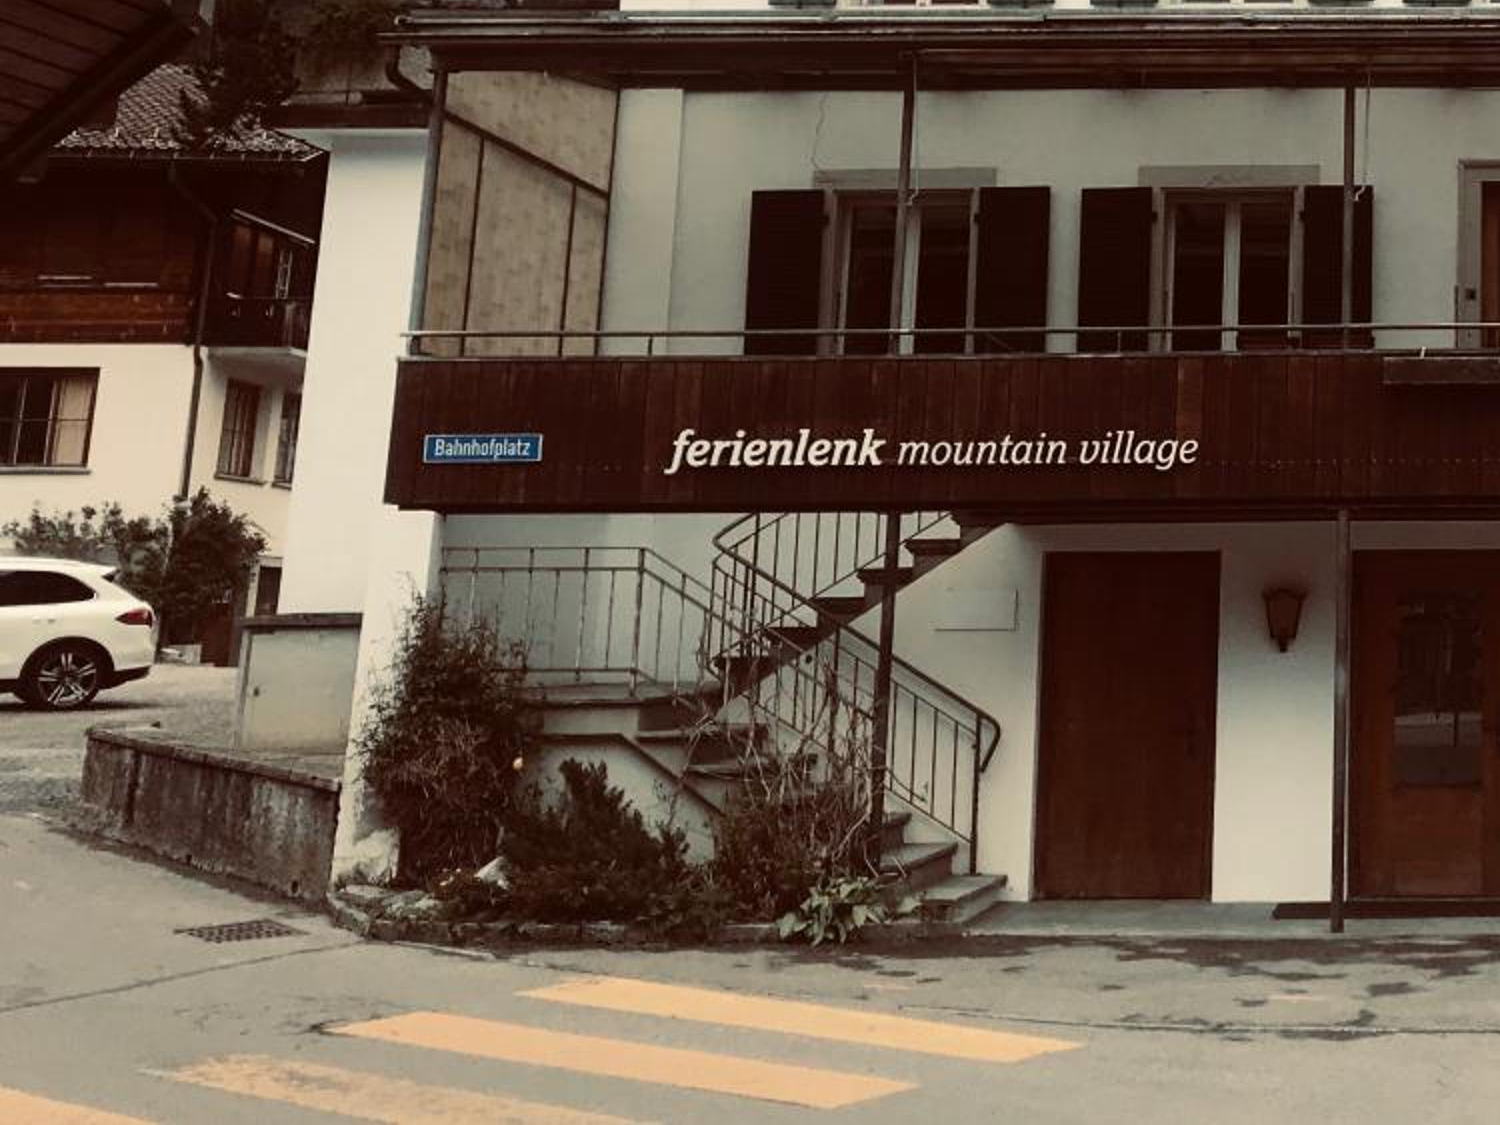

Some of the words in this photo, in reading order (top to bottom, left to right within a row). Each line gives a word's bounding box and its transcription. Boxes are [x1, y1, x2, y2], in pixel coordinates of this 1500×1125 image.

[434, 438, 531, 460] Bahnhofplatz
[664, 428, 886, 475] ferienlenk
[897, 432, 1067, 466] mountain
[1079, 430, 1199, 470] village
